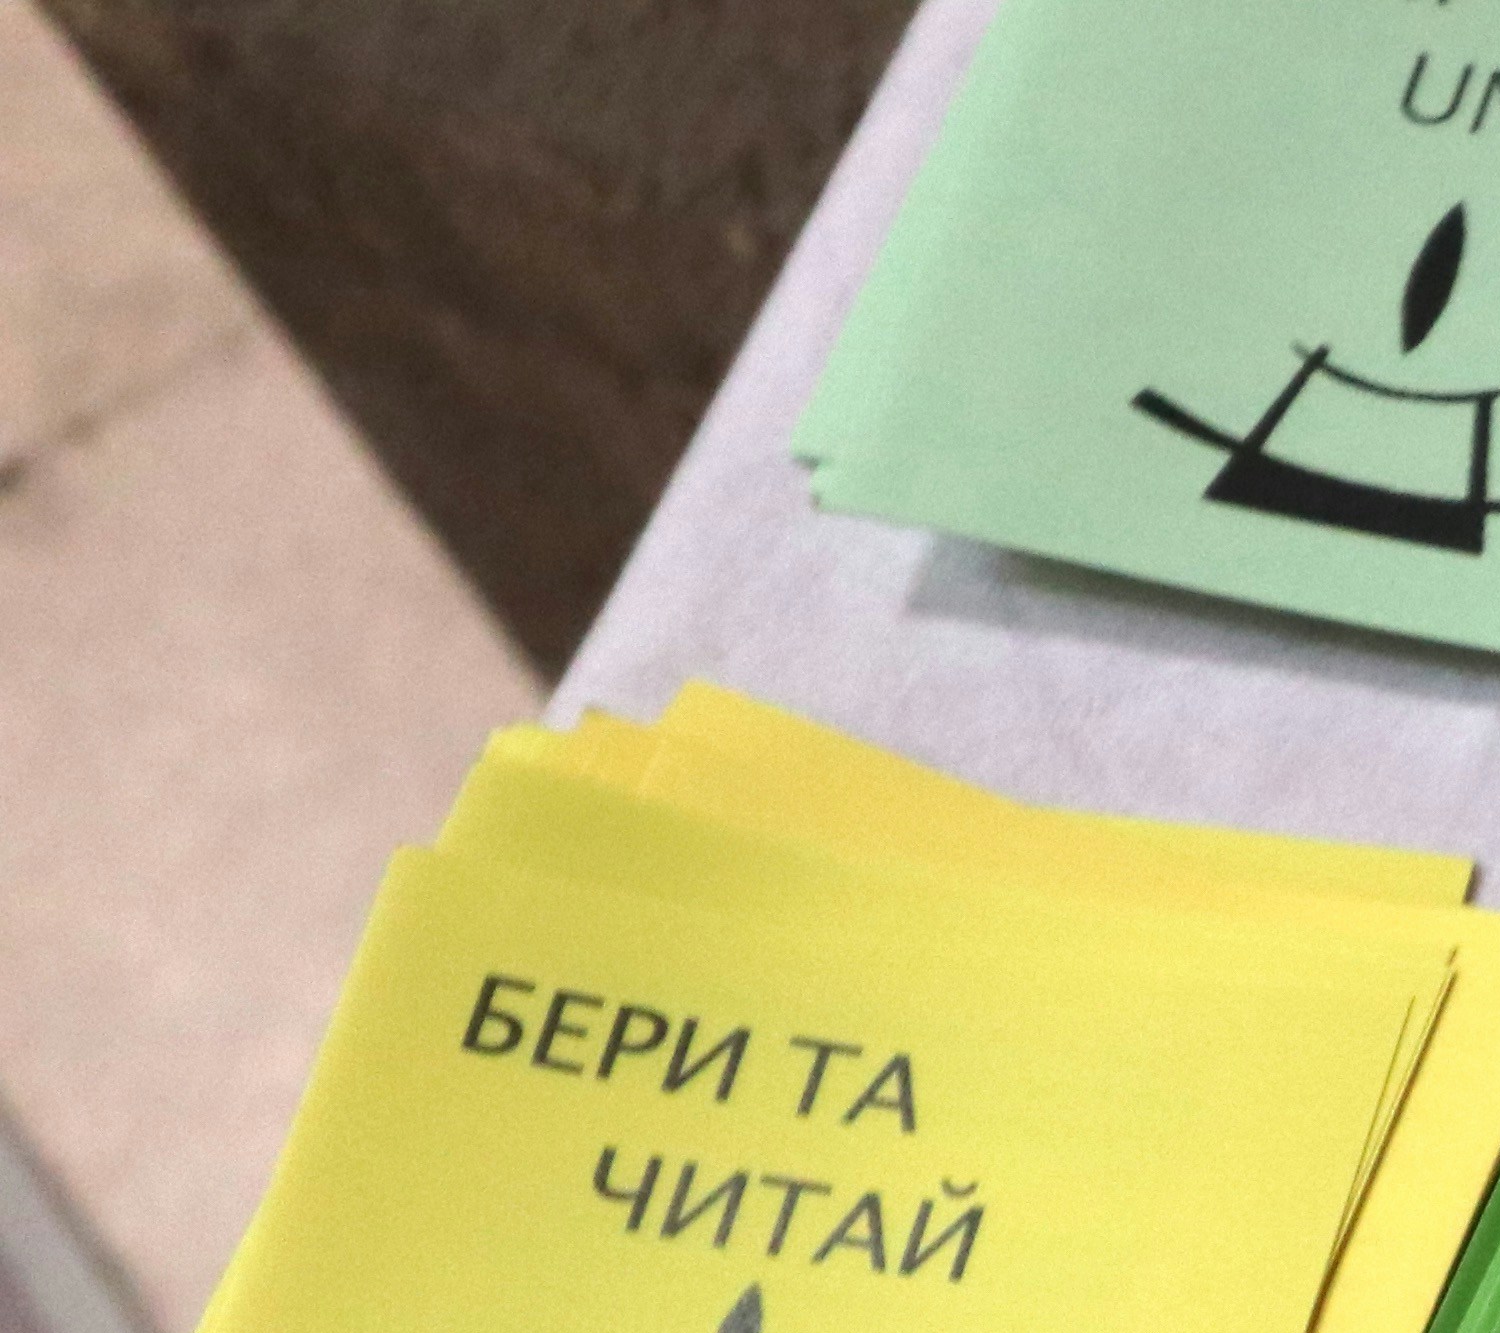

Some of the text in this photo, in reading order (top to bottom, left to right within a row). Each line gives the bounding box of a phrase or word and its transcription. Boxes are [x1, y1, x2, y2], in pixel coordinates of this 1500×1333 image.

[462, 974, 916, 1133] БЕРИ ТА
[593, 1145, 984, 1282] ЧИТАЙ
